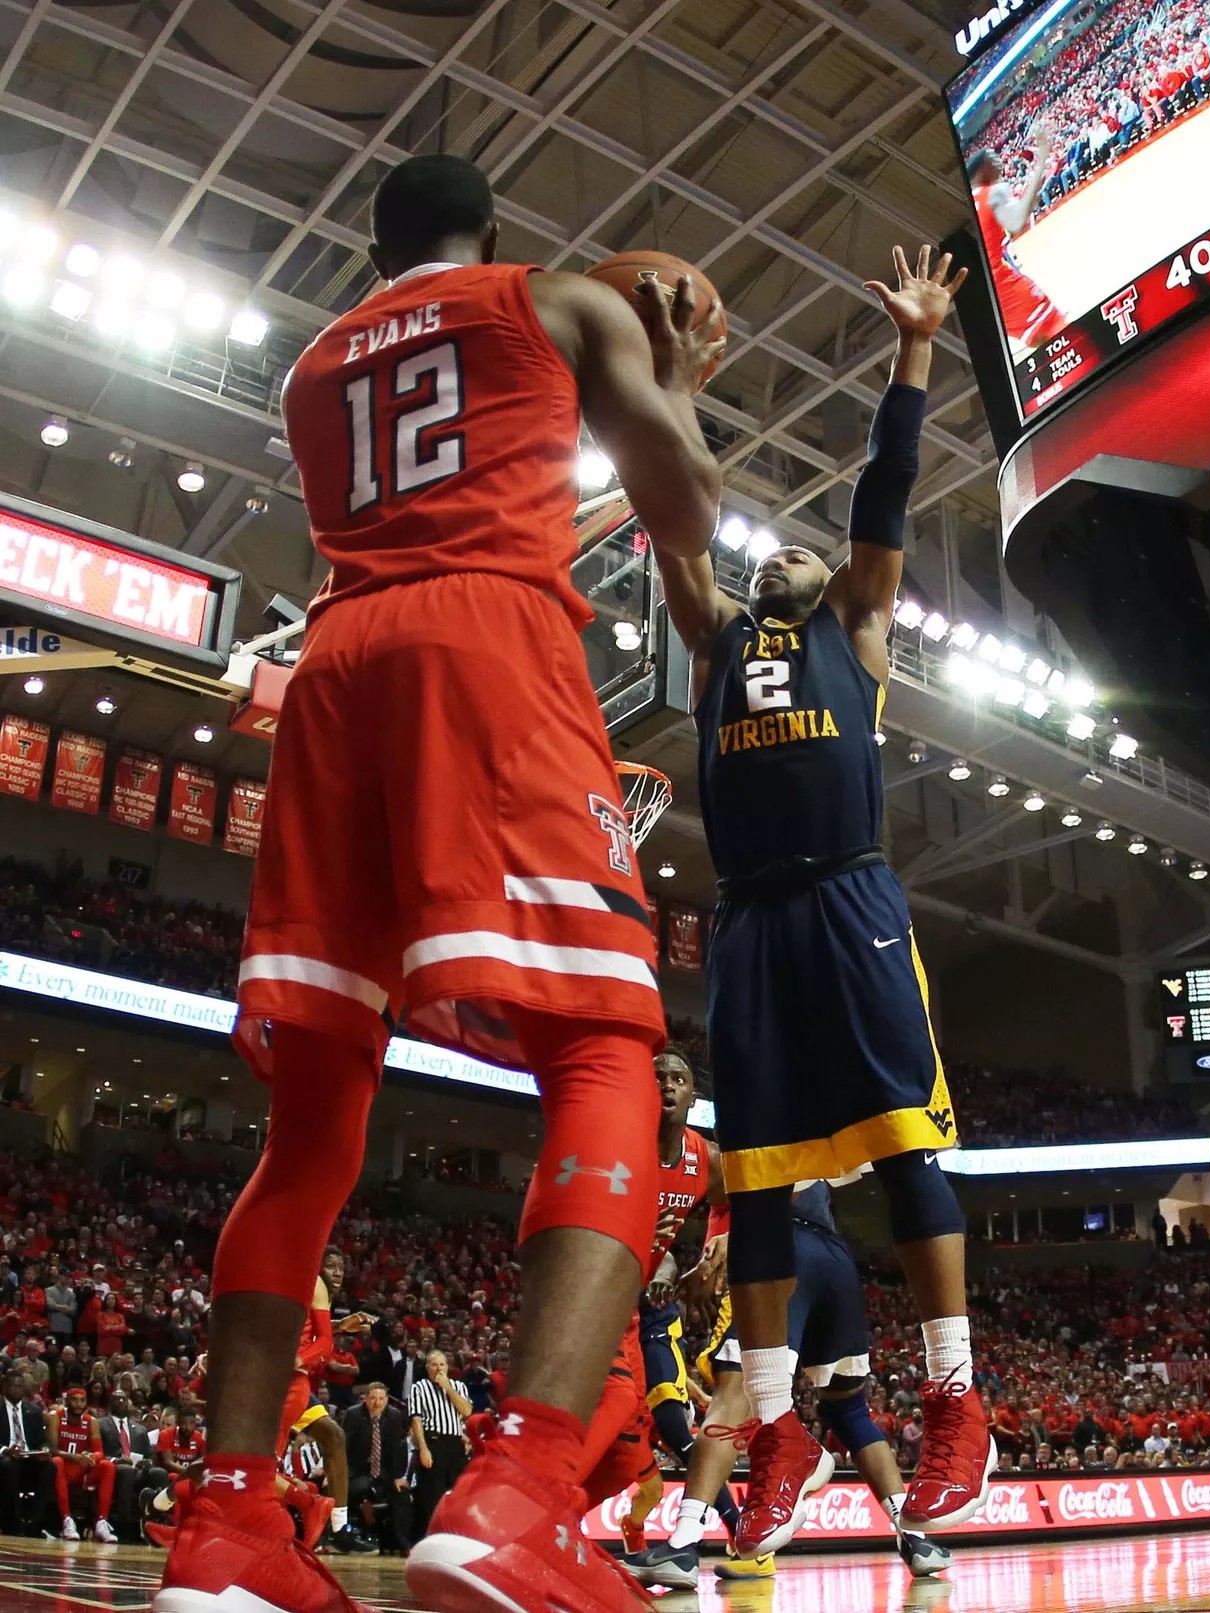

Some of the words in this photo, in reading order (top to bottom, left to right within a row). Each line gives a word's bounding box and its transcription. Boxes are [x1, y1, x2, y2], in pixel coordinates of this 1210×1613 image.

[343, 302, 441, 365] EVANS
[1027, 358, 1037, 373] 3
[1046, 336, 1070, 358] TOL
[1049, 348, 1076, 372] TEAM
[1031, 377, 1042, 392] 4
[1052, 354, 1083, 382] FOULS
[343, 340, 466, 516] 12
[103, 558, 209, 638] 'EM
[0, 627, 61, 655] lde
[742, 629, 800, 660] EST
[745, 660, 792, 713] 2
[718, 709, 840, 756] VIRGINIA
[1, 754, 41, 769] CHAMPIONS
[0, 772, 29, 786] CLASSIC
[58, 769, 99, 784] CHAMPIONS
[56, 786, 86, 800] CLASSIC
[115, 786, 156, 803] CHAMPIONS
[116, 805, 149, 819] CLASSIC
[172, 809, 186, 820] EAST
[182, 804, 203, 816] NCAA
[18, 963, 74, 1000] Every
[85, 982, 167, 1014] moment
[172, 1001, 234, 1028] matter
[405, 1046, 453, 1078] Every
[667, 1193, 695, 1207] TECH
[1058, 1481, 1134, 1521] Coca-Cola
